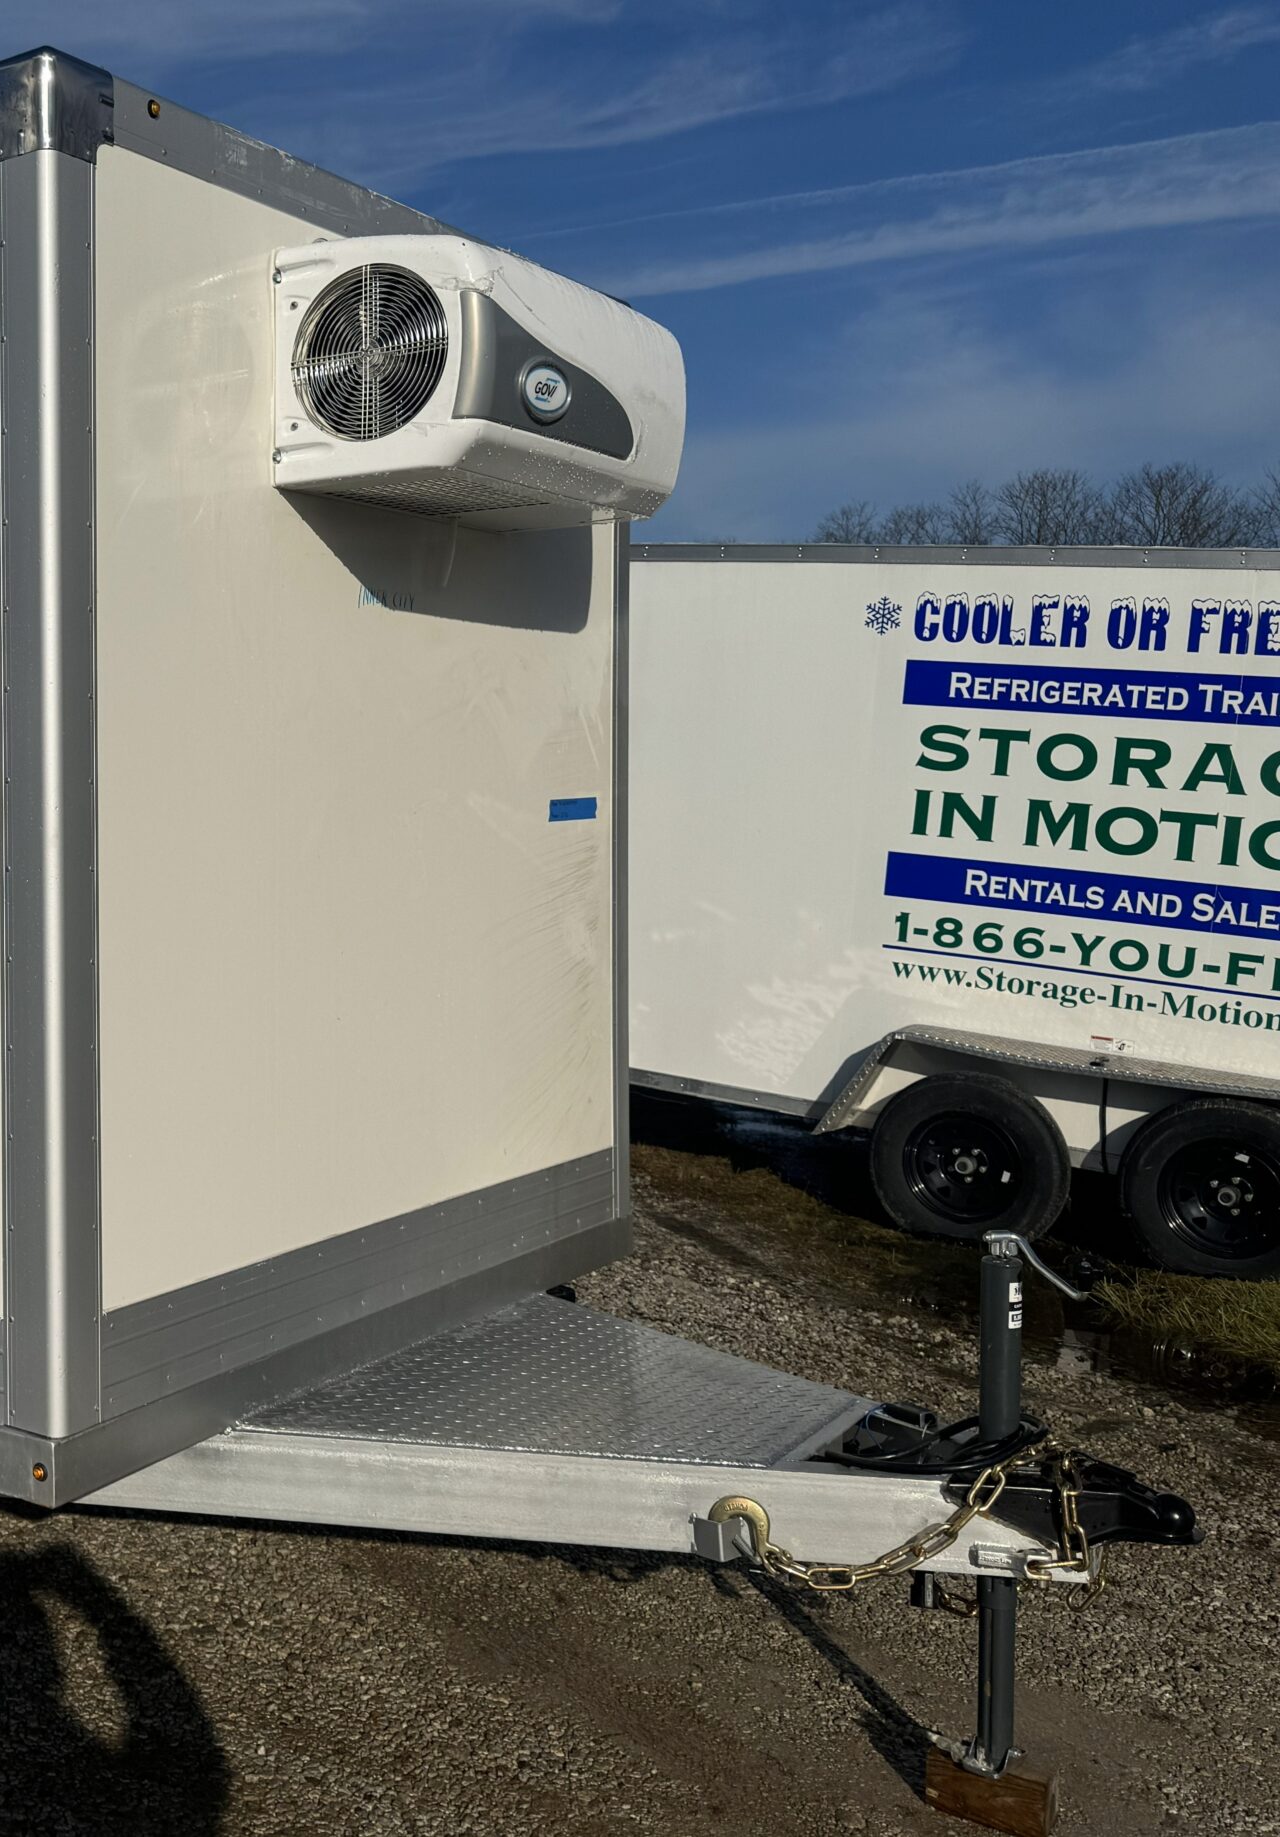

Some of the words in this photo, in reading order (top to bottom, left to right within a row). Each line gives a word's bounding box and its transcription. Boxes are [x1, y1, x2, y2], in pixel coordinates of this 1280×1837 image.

[534, 380, 558, 398] GOVI
[914, 591, 1090, 648] COOLER
[1106, 596, 1170, 652] OR
[1186, 597, 1280, 657] FRE
[948, 671, 1189, 712] REFRIGERATED
[1198, 683, 1280, 717] TRAI
[910, 788, 999, 842] IN
[964, 868, 1105, 911] RENTALS
[1112, 890, 1183, 919] AND
[1190, 892, 1280, 931] SALE
